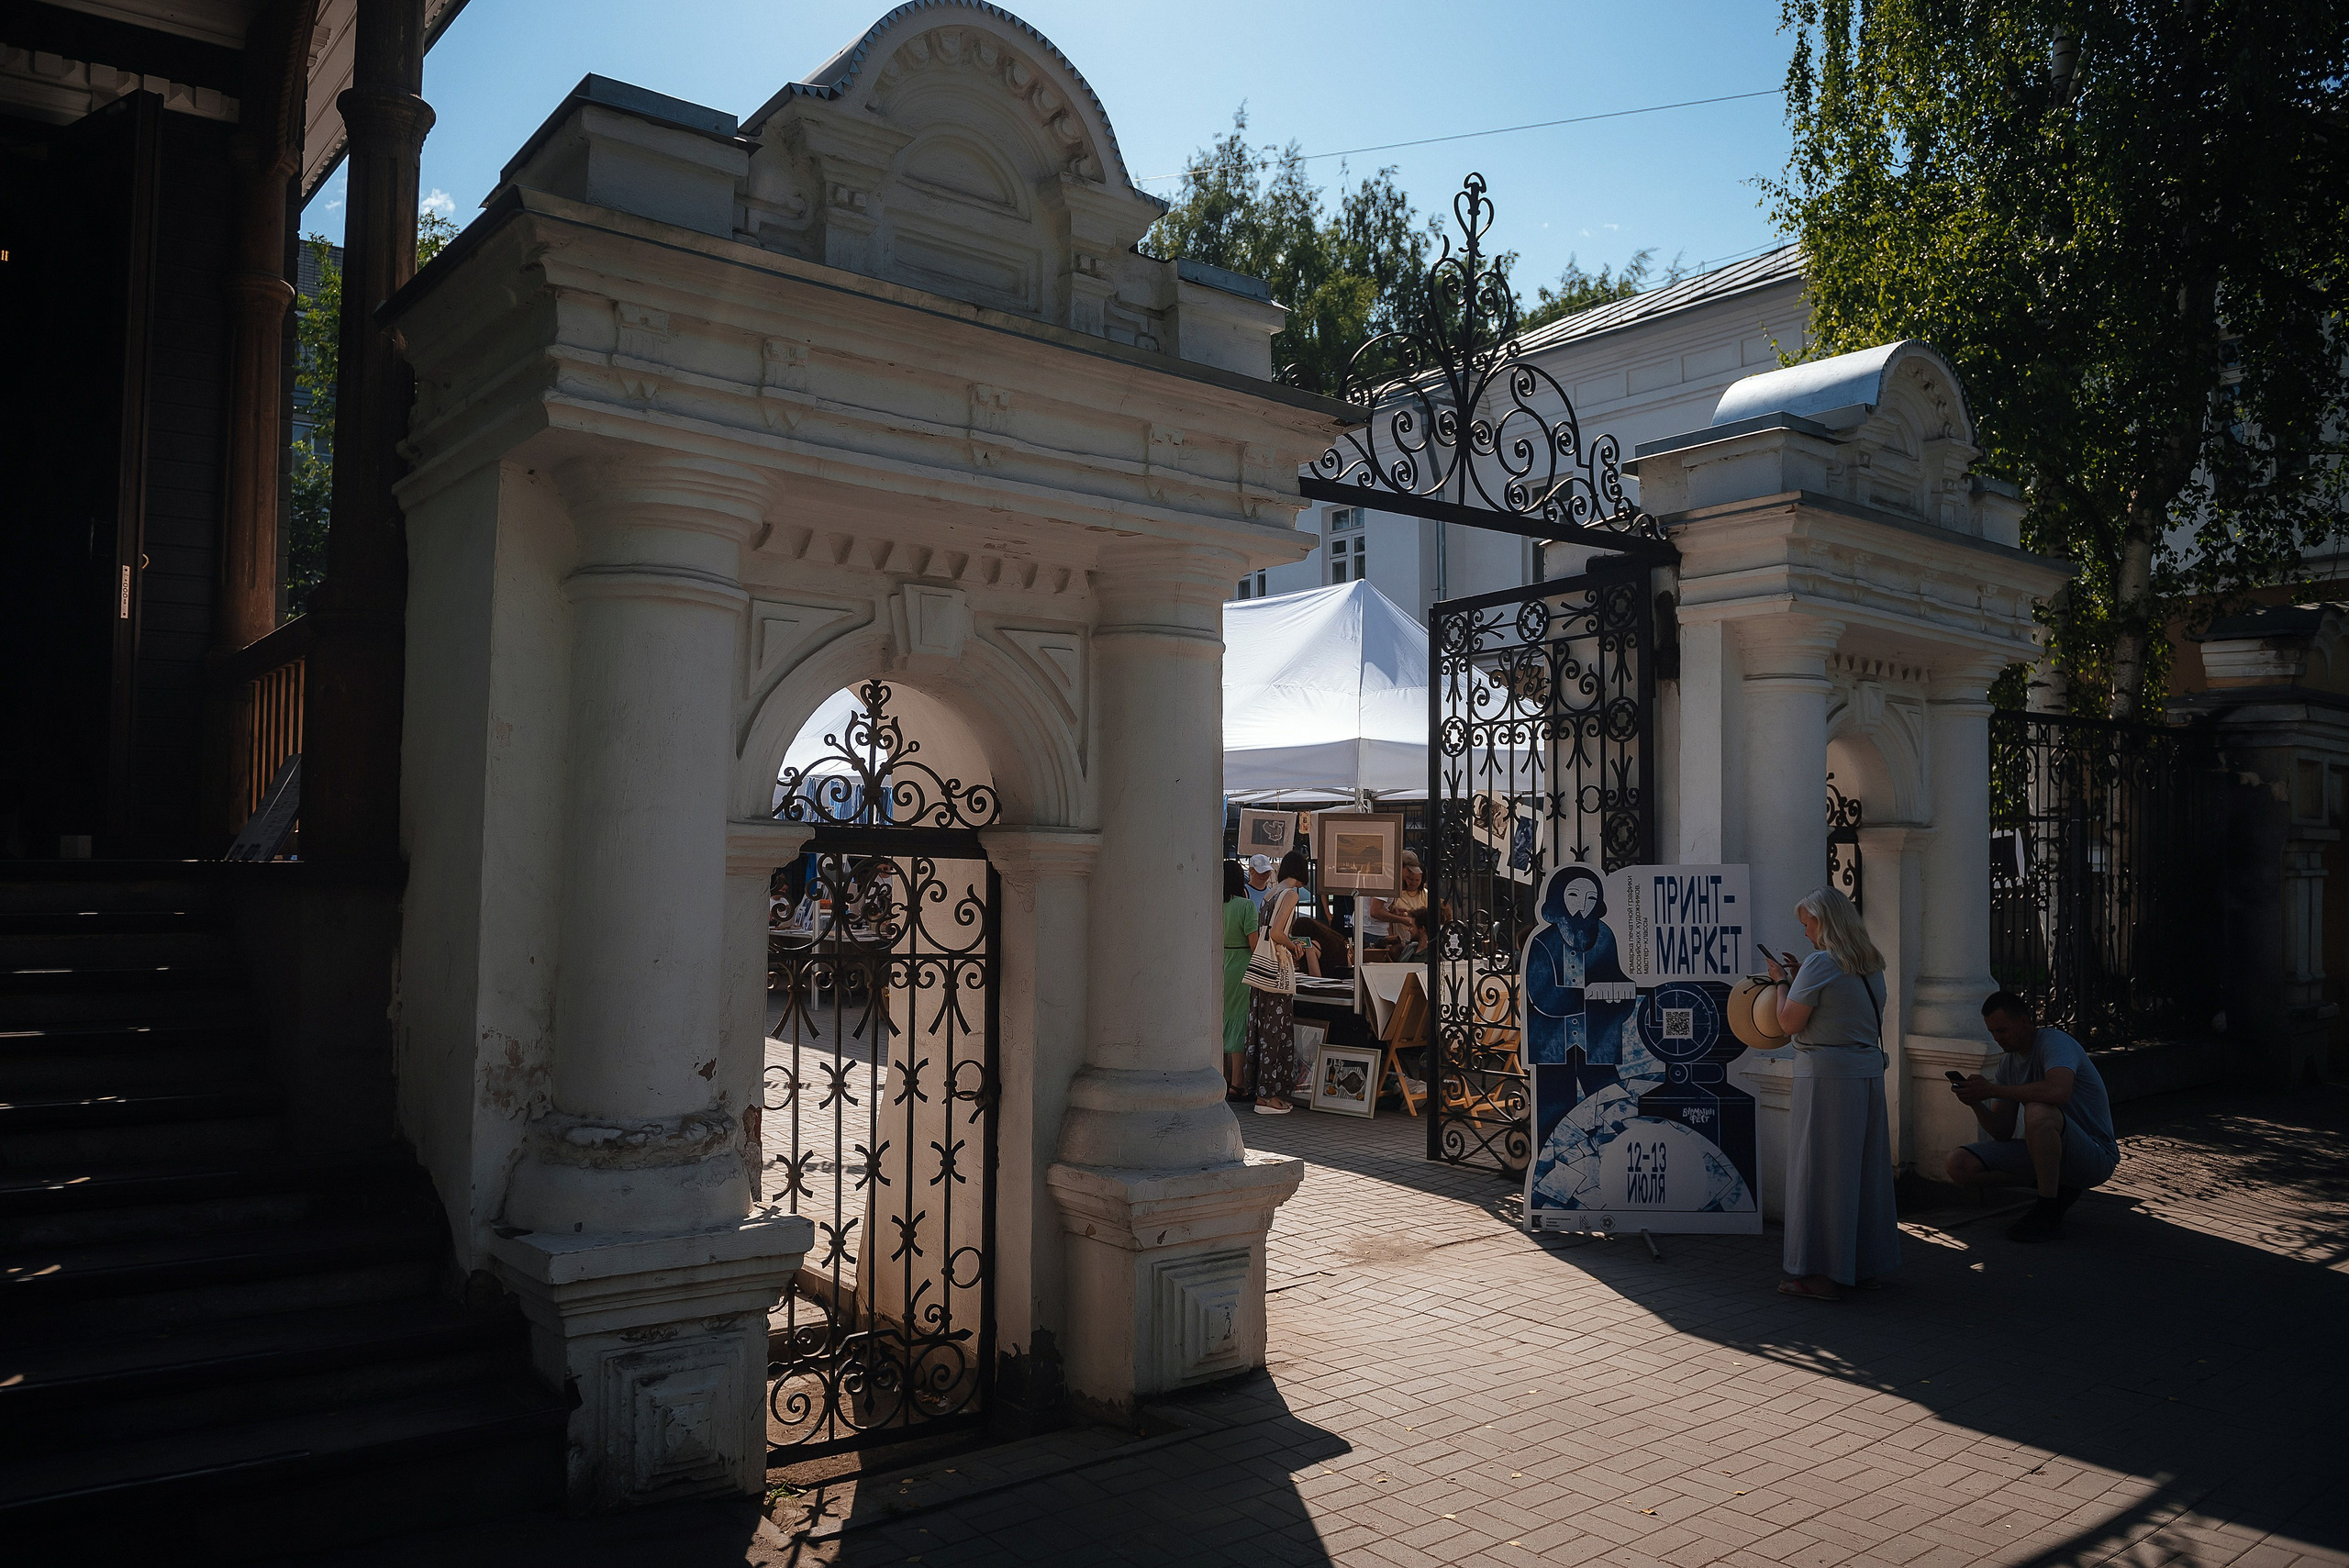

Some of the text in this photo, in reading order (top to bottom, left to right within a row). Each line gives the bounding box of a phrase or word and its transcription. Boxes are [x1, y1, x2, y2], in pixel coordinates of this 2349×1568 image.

[1653, 875, 1736, 924] ПРИНТ-
[1655, 926, 1742, 974] МАРКЕТ
[1689, 1114, 1710, 1124] ФЕСТ
[1627, 1141, 1666, 1173] 12-13
[1627, 1173, 1665, 1204] ИЮЛЯ
